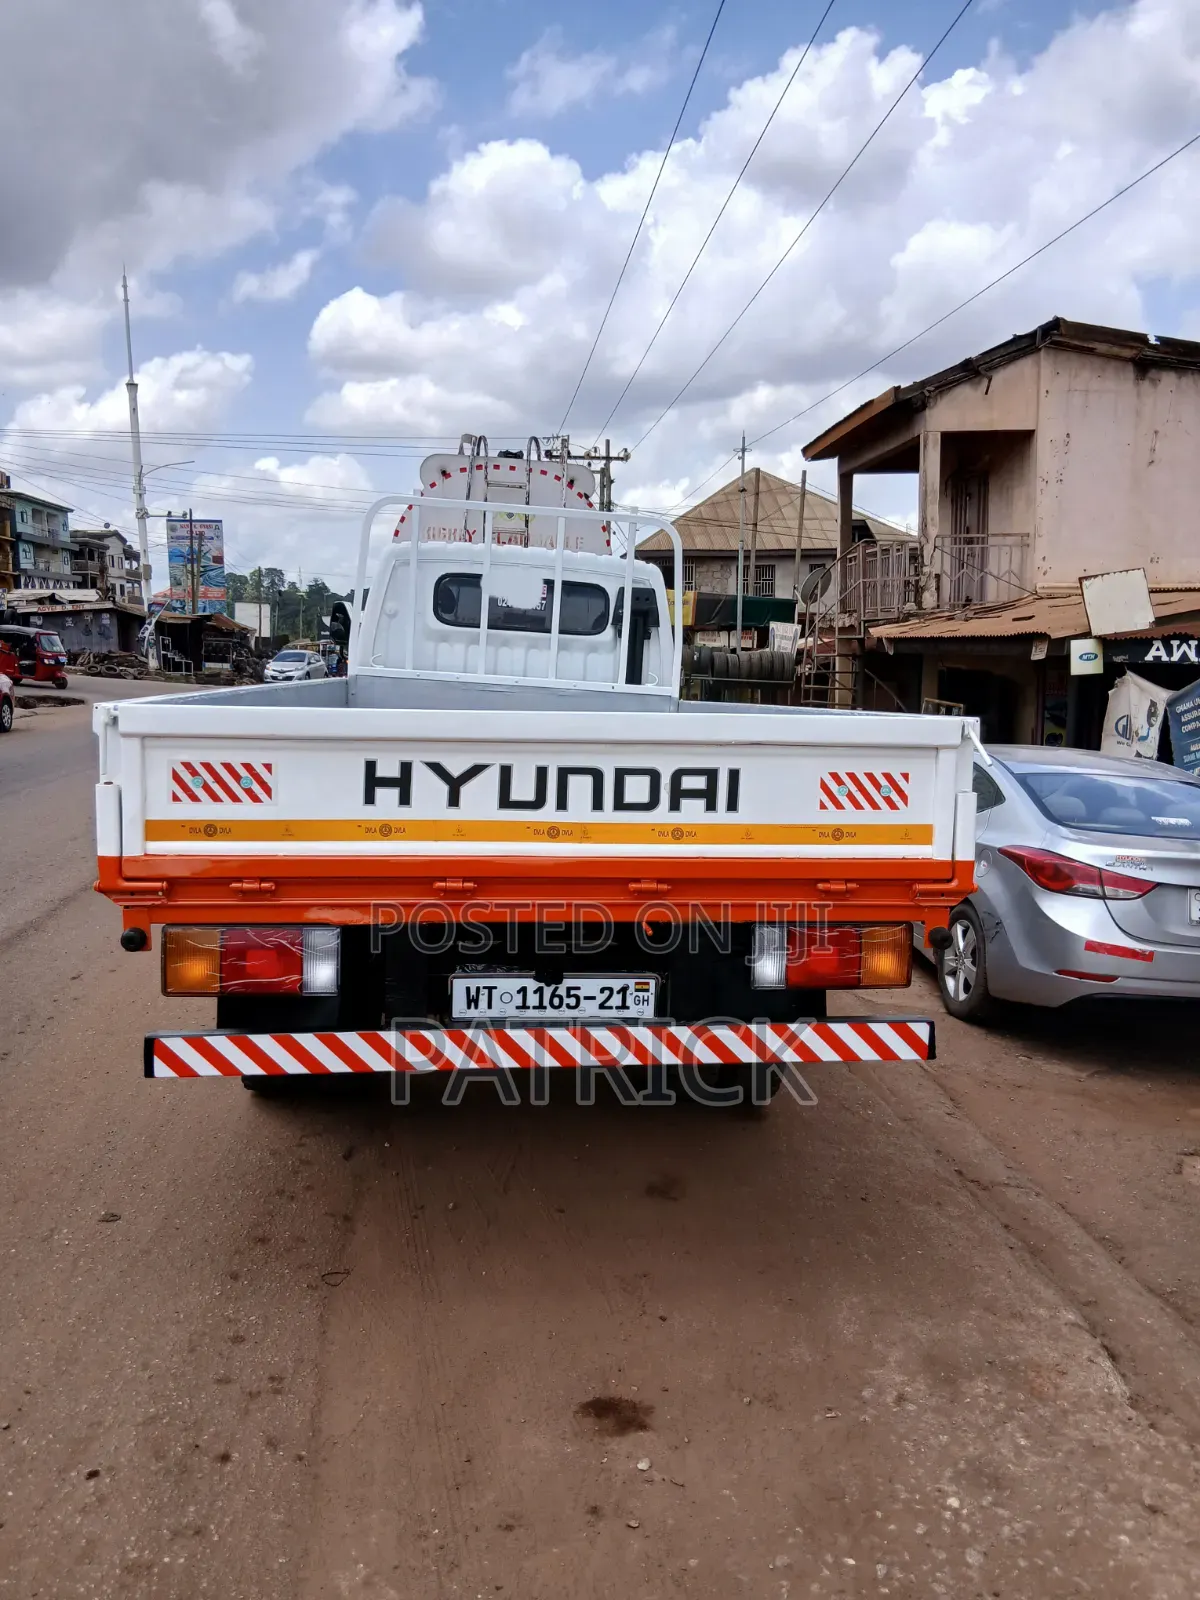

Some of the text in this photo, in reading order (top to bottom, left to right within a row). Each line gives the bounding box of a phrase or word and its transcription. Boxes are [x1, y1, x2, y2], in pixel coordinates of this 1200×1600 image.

[1144, 639, 1200, 662] AW
[362, 757, 741, 814] HYUNDAI
[465, 985, 650, 1011] WT 1165-21 GH
